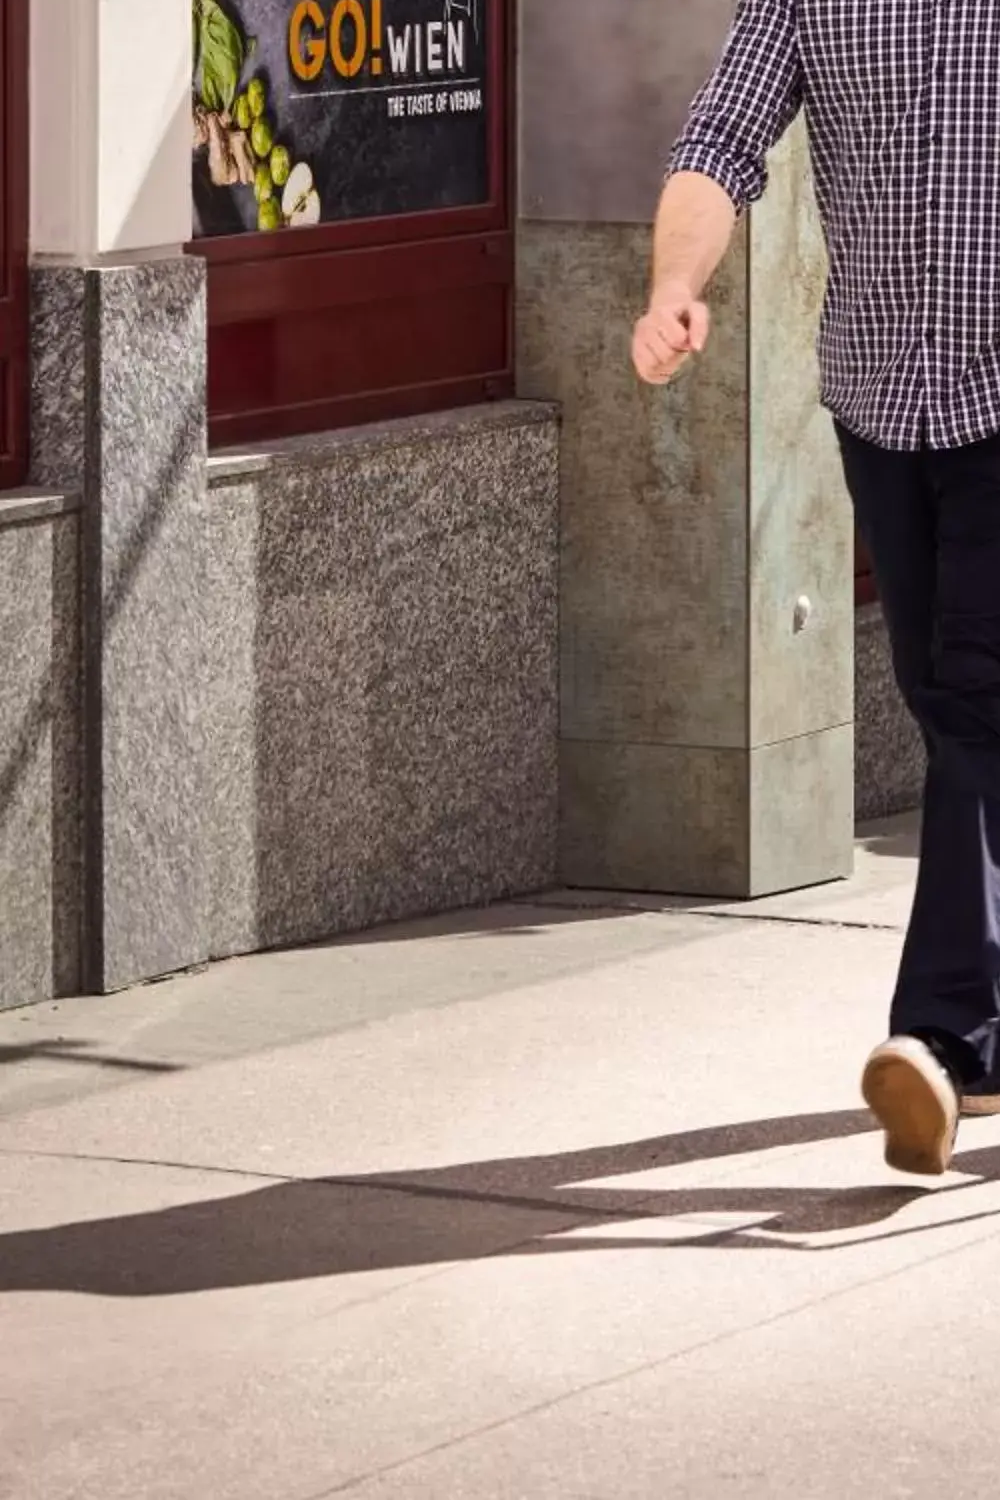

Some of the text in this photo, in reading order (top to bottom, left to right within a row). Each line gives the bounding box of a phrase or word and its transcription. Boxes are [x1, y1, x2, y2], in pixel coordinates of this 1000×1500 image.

[386, 20, 467, 75] WIEN
[387, 95, 405, 118] THE
[406, 92, 434, 117] TASTE
[435, 90, 448, 113] OF
